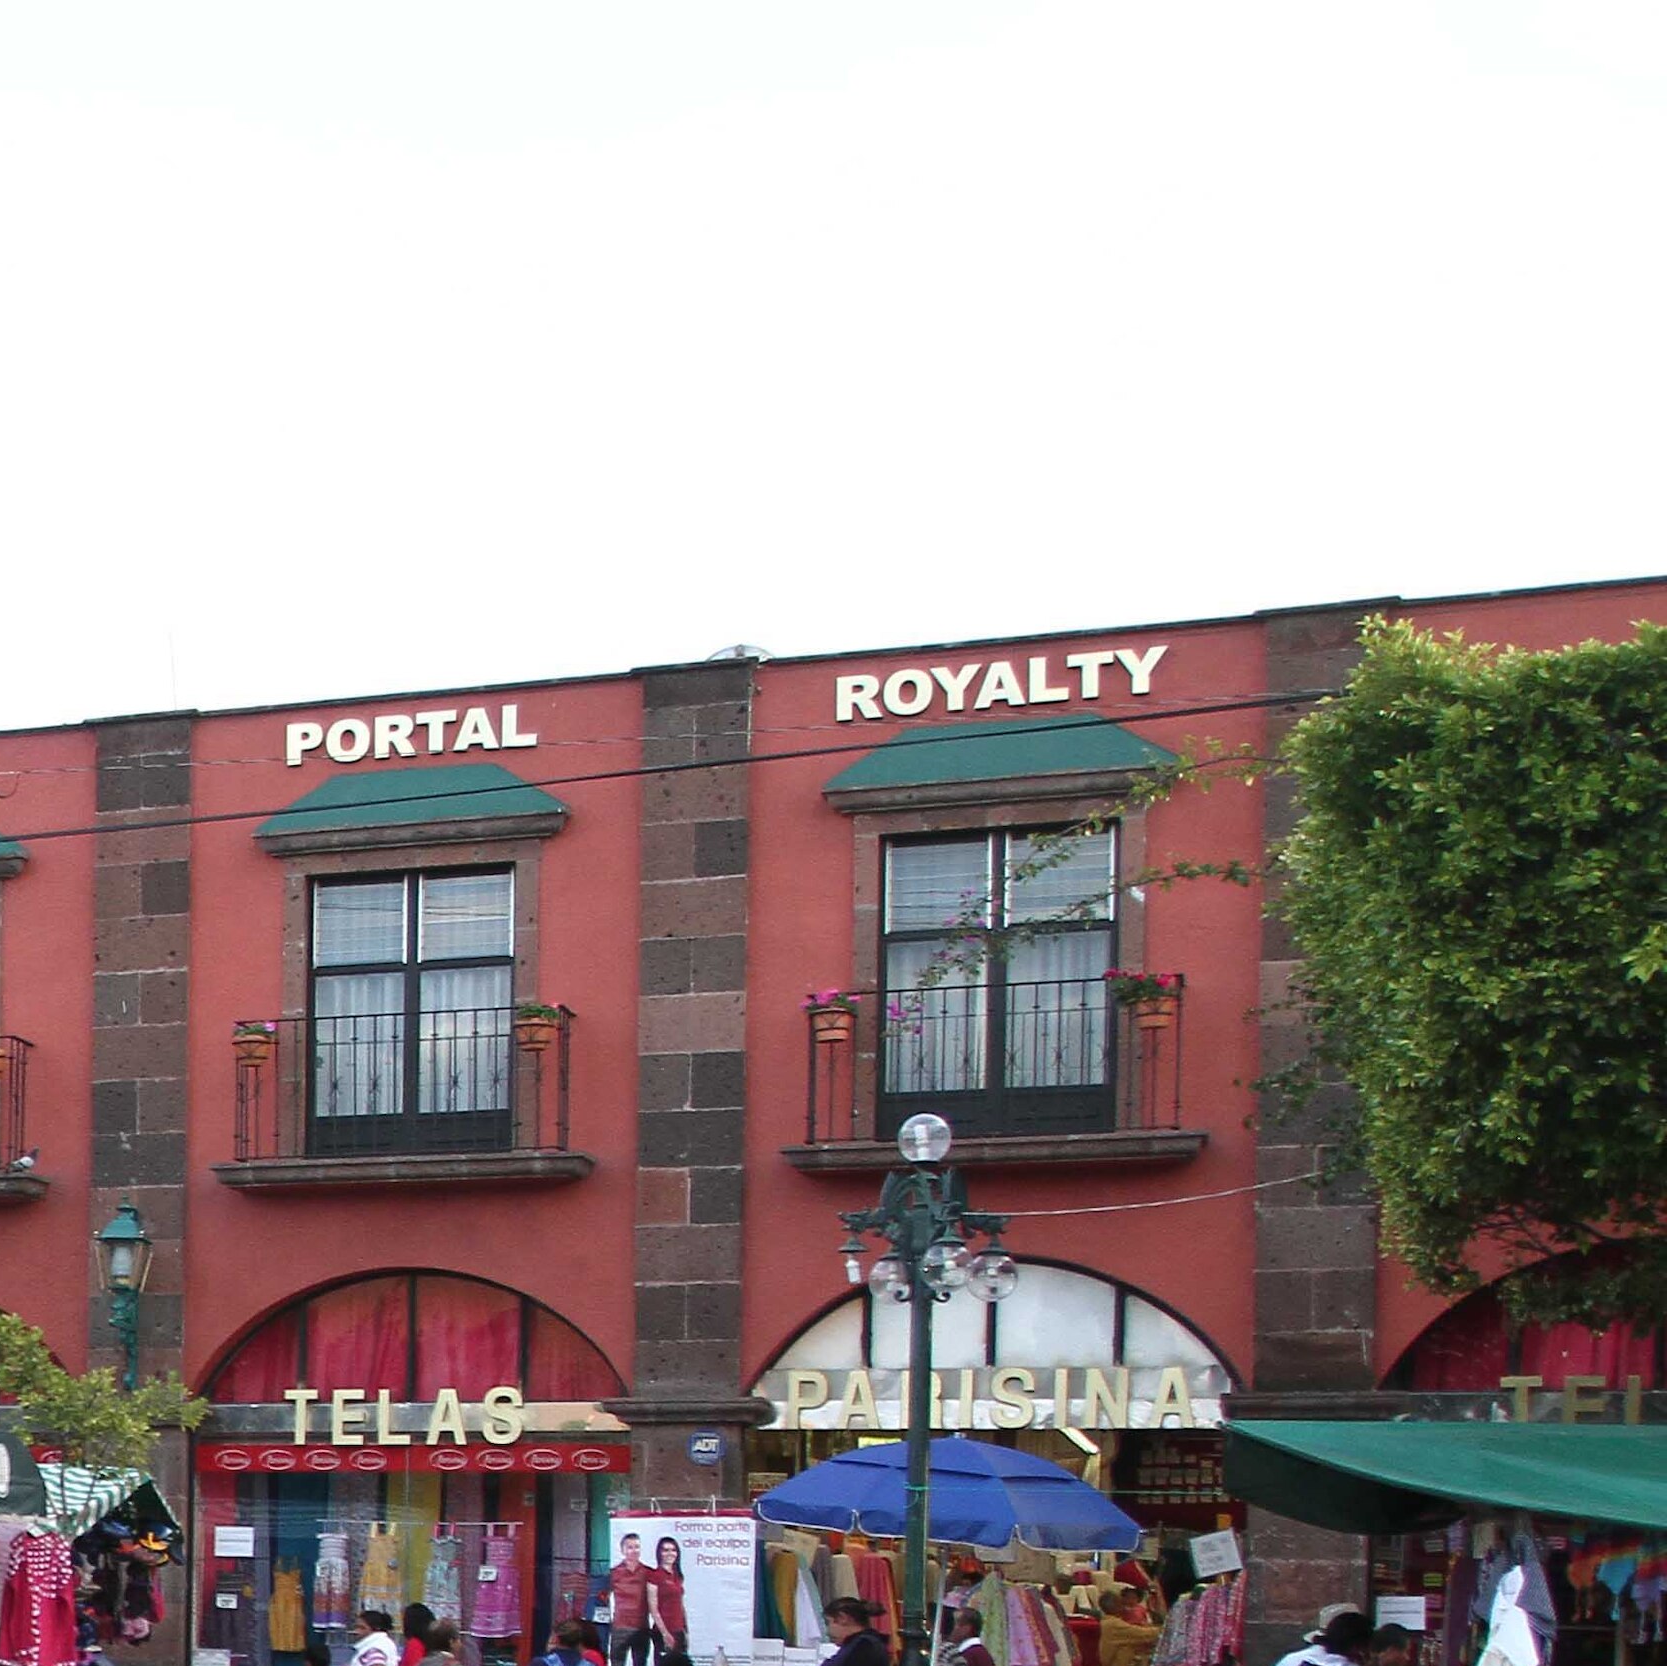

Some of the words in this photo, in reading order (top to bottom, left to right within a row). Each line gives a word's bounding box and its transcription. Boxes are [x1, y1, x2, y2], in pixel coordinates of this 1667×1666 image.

[835, 646, 1168, 722] ROYALTY
[286, 704, 538, 766] PORTAL
[284, 1386, 525, 1446] TELAS
[786, 1366, 1196, 1429] PARISINA
[692, 1438, 720, 1453] ADT
[675, 1521, 713, 1532] Forma
[716, 1521, 750, 1534] parte
[682, 1537, 703, 1548] del
[705, 1538, 750, 1552] equipo
[696, 1554, 750, 1567] Parisina
